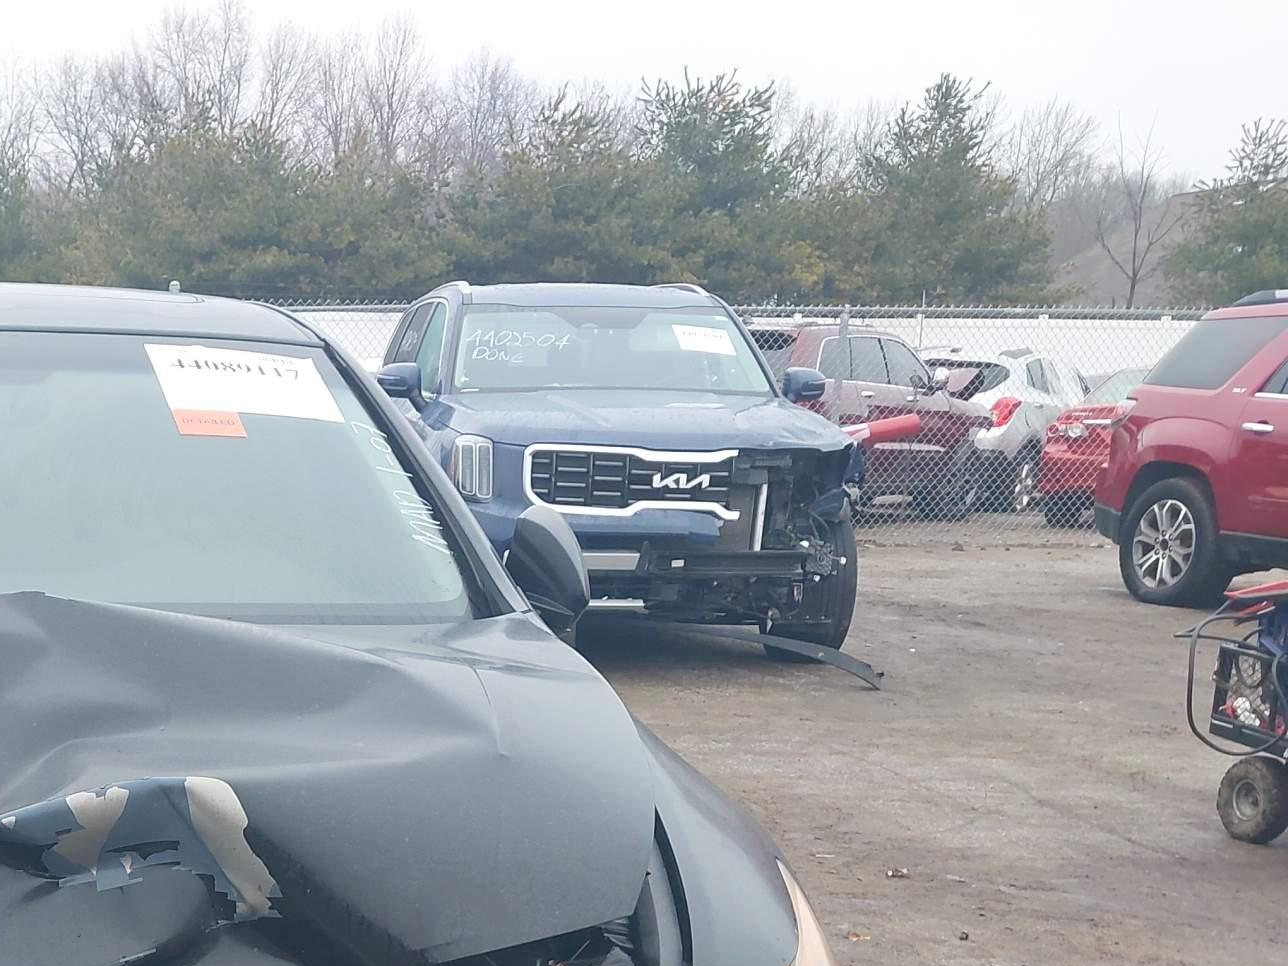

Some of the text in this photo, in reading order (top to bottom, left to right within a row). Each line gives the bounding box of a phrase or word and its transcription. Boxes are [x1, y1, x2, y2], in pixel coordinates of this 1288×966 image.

[472, 346, 525, 363] DONE
[169, 358, 299, 380] 44089117
[652, 472, 711, 489] KIA
